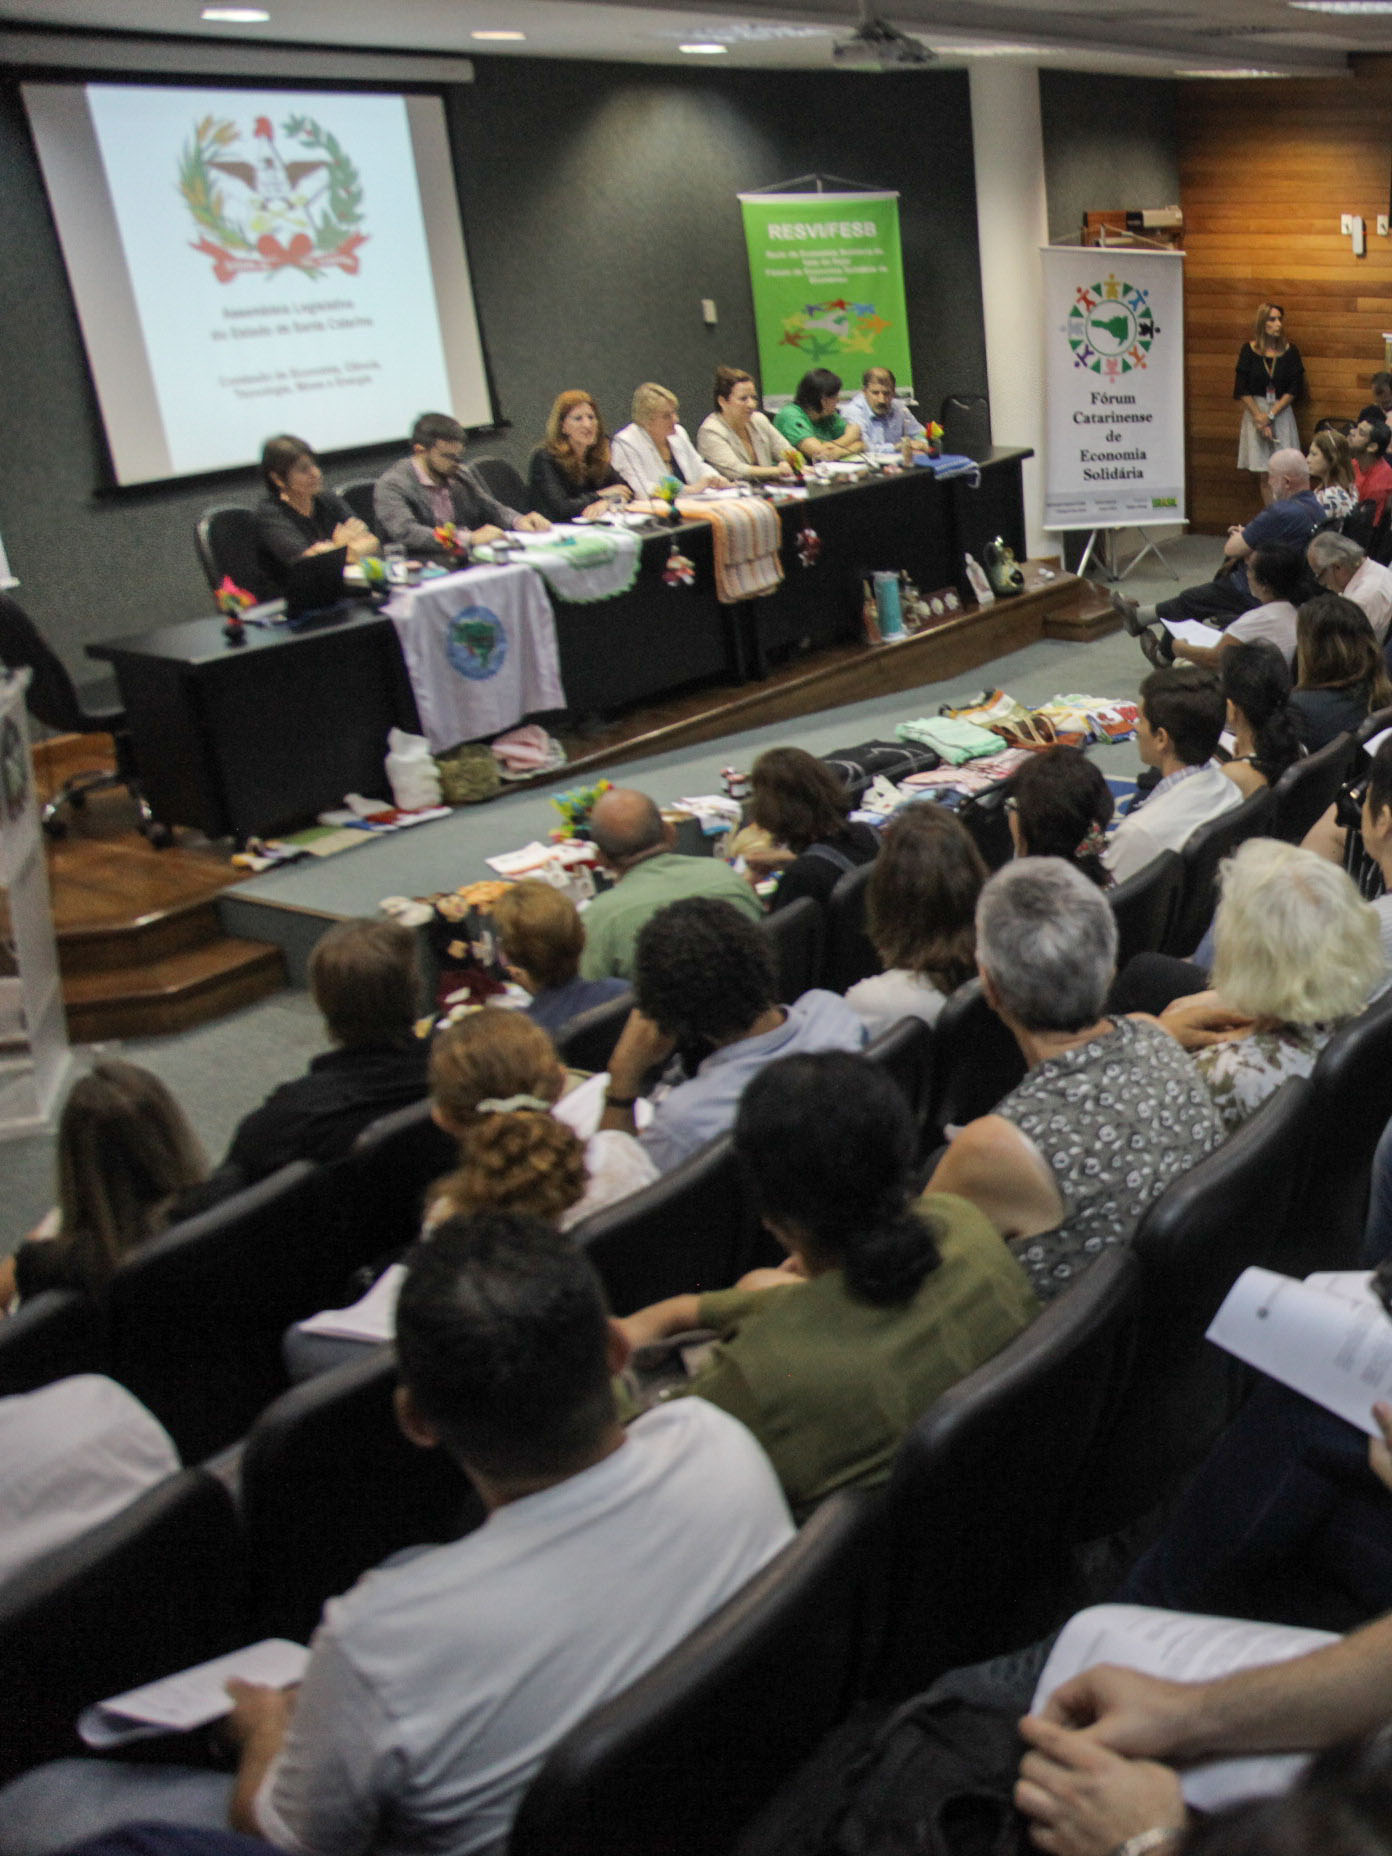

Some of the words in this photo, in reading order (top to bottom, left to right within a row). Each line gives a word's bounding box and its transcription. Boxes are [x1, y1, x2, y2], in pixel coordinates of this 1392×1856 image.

[1090, 391, 1137, 405] Fórum
[1072, 410, 1153, 424] Catarinense
[1105, 429, 1122, 442] de
[1080, 447, 1147, 462] Economia
[1083, 465, 1145, 481] Solidária
